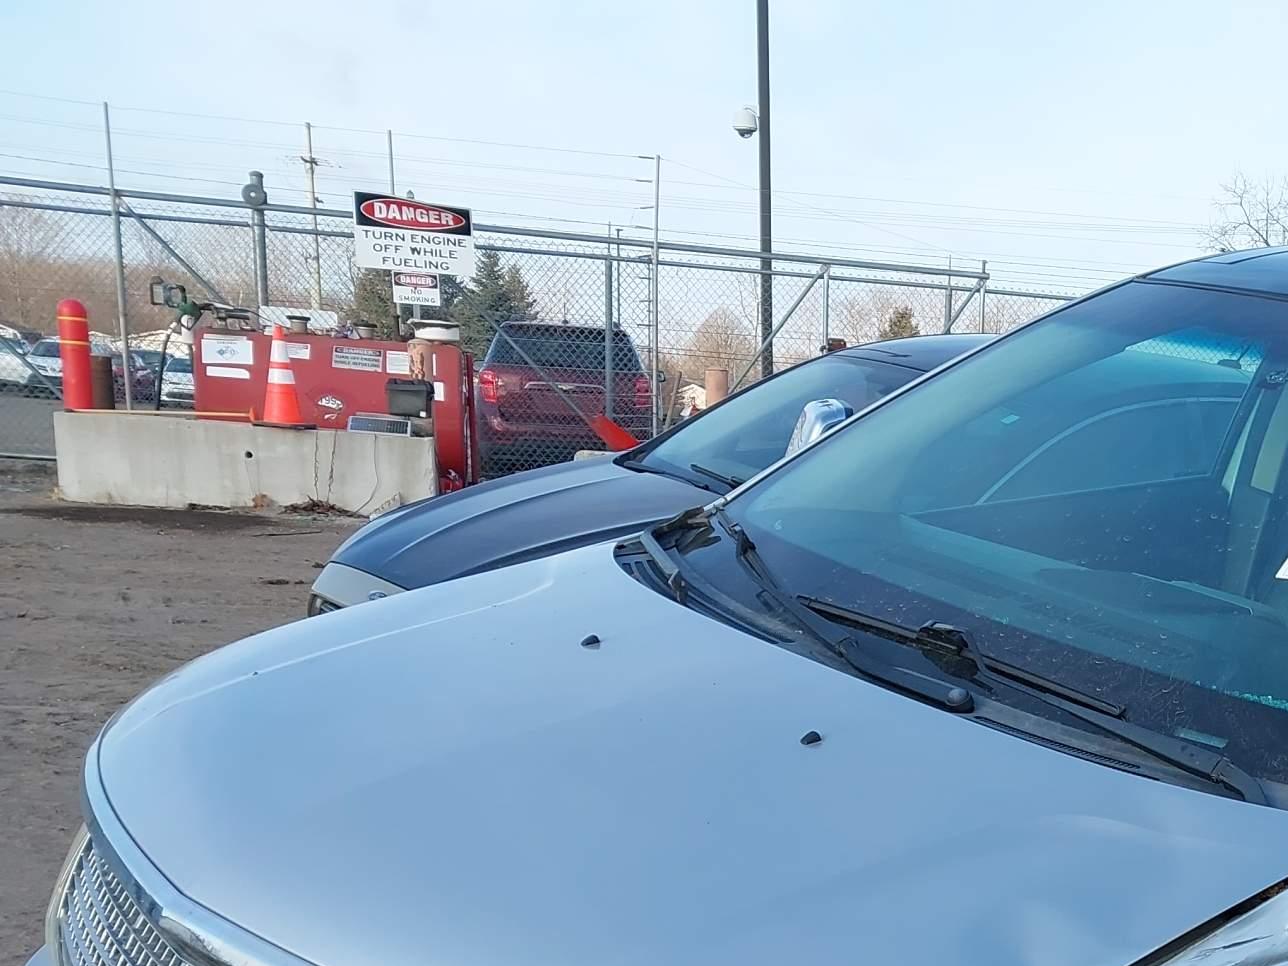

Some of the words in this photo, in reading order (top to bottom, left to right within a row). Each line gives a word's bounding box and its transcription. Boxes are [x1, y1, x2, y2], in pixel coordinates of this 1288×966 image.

[373, 202, 454, 225] DANGER
[362, 229, 405, 241] TURN
[411, 235, 467, 248] ENGINE
[372, 243, 404, 254] OFF
[409, 246, 458, 260] WHILE
[382, 256, 451, 271] FUELING
[400, 275, 433, 286] DANGER
[398, 295, 436, 303] SMOKING
[410, 288, 423, 296] NO
